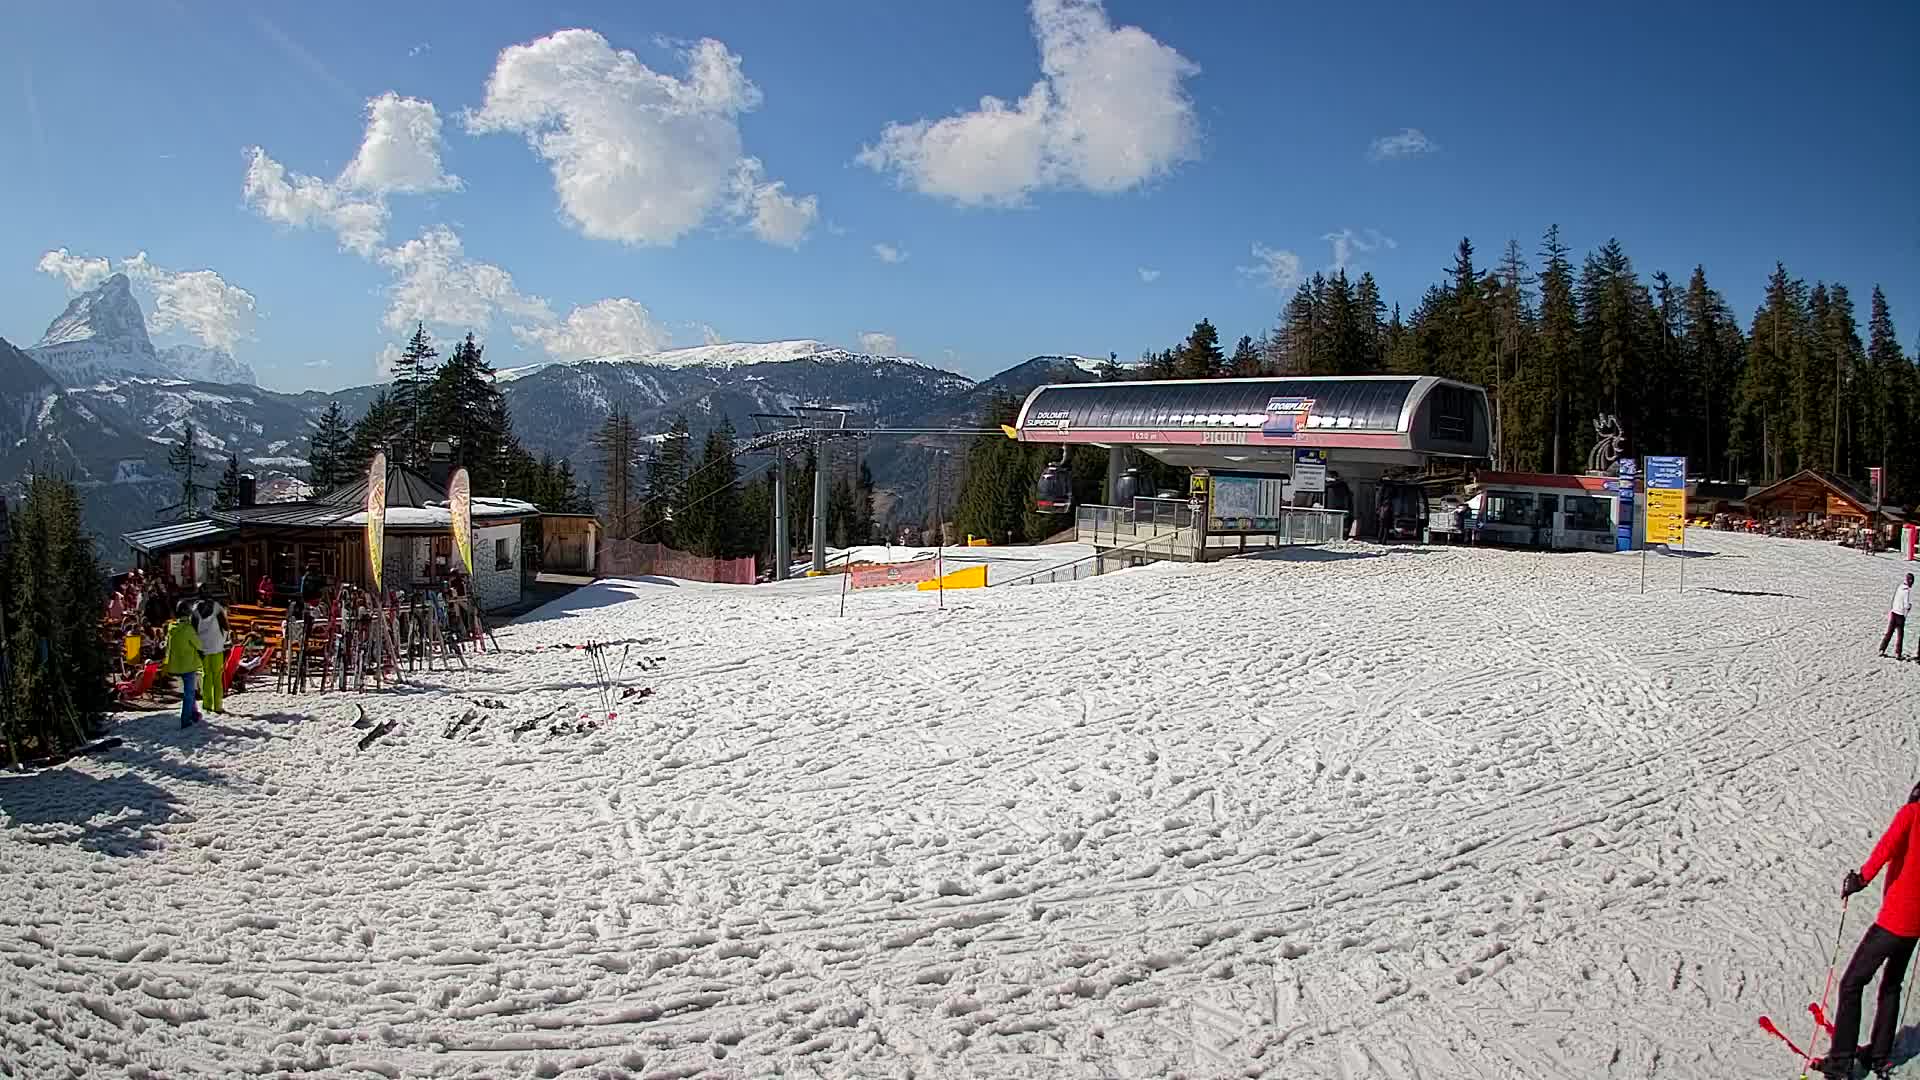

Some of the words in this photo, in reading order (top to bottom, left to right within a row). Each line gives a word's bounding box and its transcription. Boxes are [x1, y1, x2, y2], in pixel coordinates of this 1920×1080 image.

[1268, 402, 1313, 411] KRONPLATZ
[1037, 411, 1069, 419] DOLOMITI
[1202, 431, 1247, 444] PICULIN
